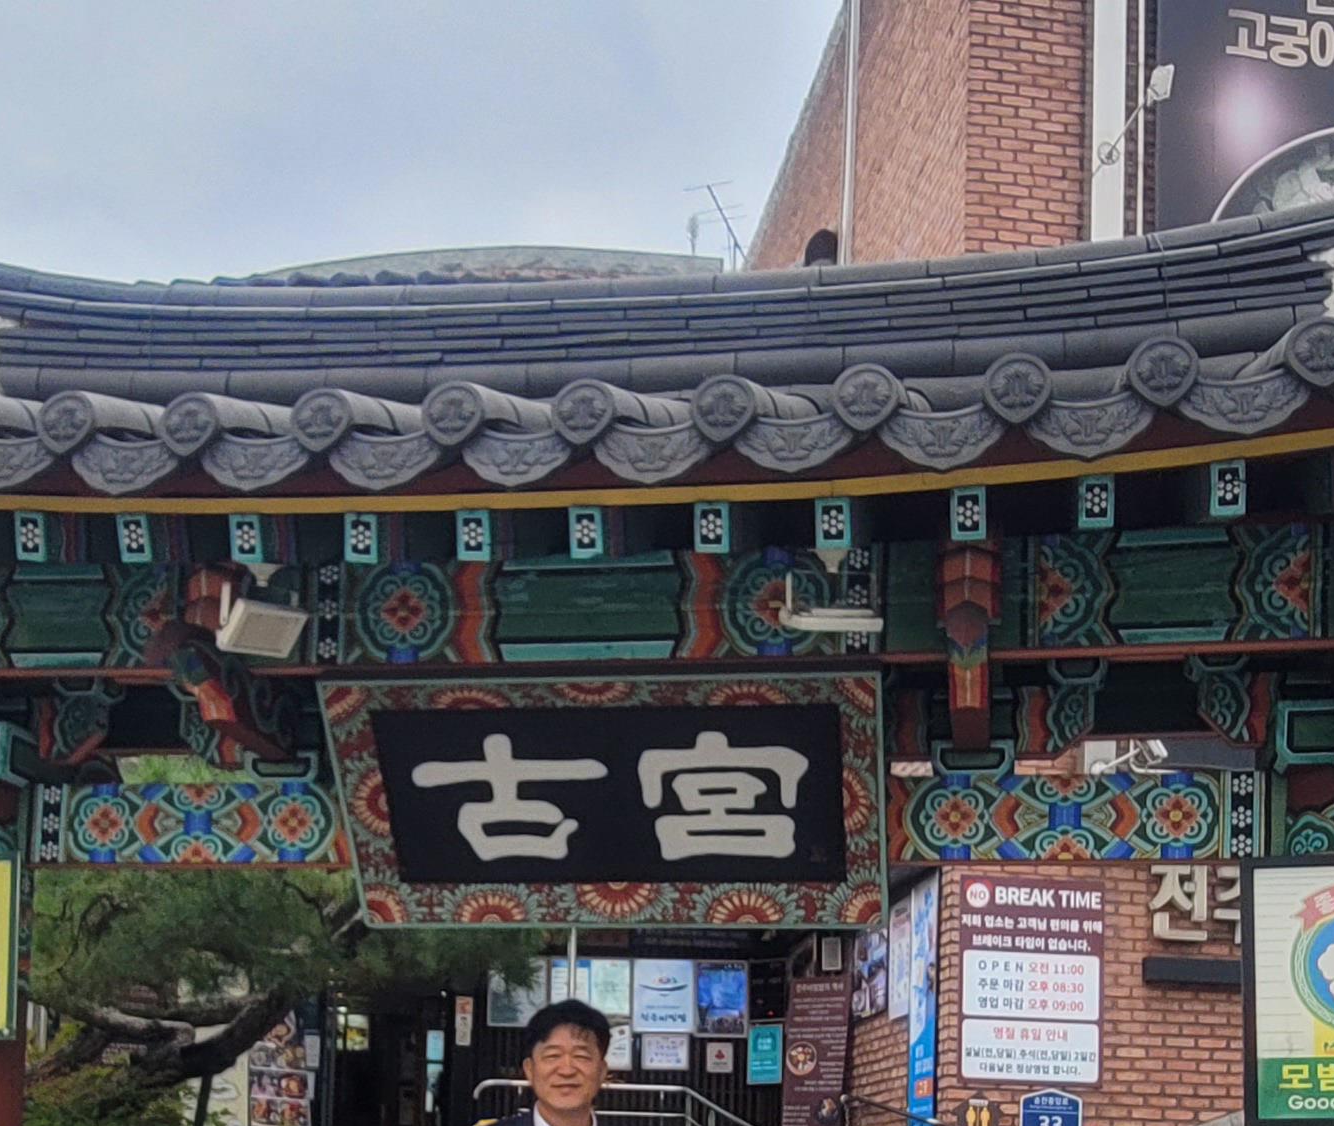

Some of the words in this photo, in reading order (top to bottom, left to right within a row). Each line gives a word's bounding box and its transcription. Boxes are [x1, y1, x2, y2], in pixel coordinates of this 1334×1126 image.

[411, 730, 809, 861] 古宮
[969, 889, 987, 901] NO
[995, 886, 1056, 907] BREAK
[1058, 890, 1102, 910] TIME
[961, 914, 982, 928] 저희
[984, 915, 1014, 929] 업소는
[1017, 917, 1047, 931] 고객님
[1082, 920, 1103, 934] 위해
[972, 934, 1012, 948] 브레이크
[1015, 936, 1045, 950] 타임이
[1028, 962, 1049, 975] 오전
[1053, 964, 1084, 976] 11:00
[978, 977, 999, 991] 주문
[1003, 978, 1024, 992] 마감
[1028, 980, 1049, 993] 오후
[1052, 982, 1084, 994] 08:30
[978, 995, 999, 1009] 영업
[1003, 996, 1024, 1011] 마감
[1028, 998, 1049, 1011] 오후
[1052, 1000, 1084, 1012] 09:00
[993, 1026, 1015, 1040] 명절
[1020, 1028, 1041, 1041] 휴일
[1046, 1029, 1068, 1043] 안내
